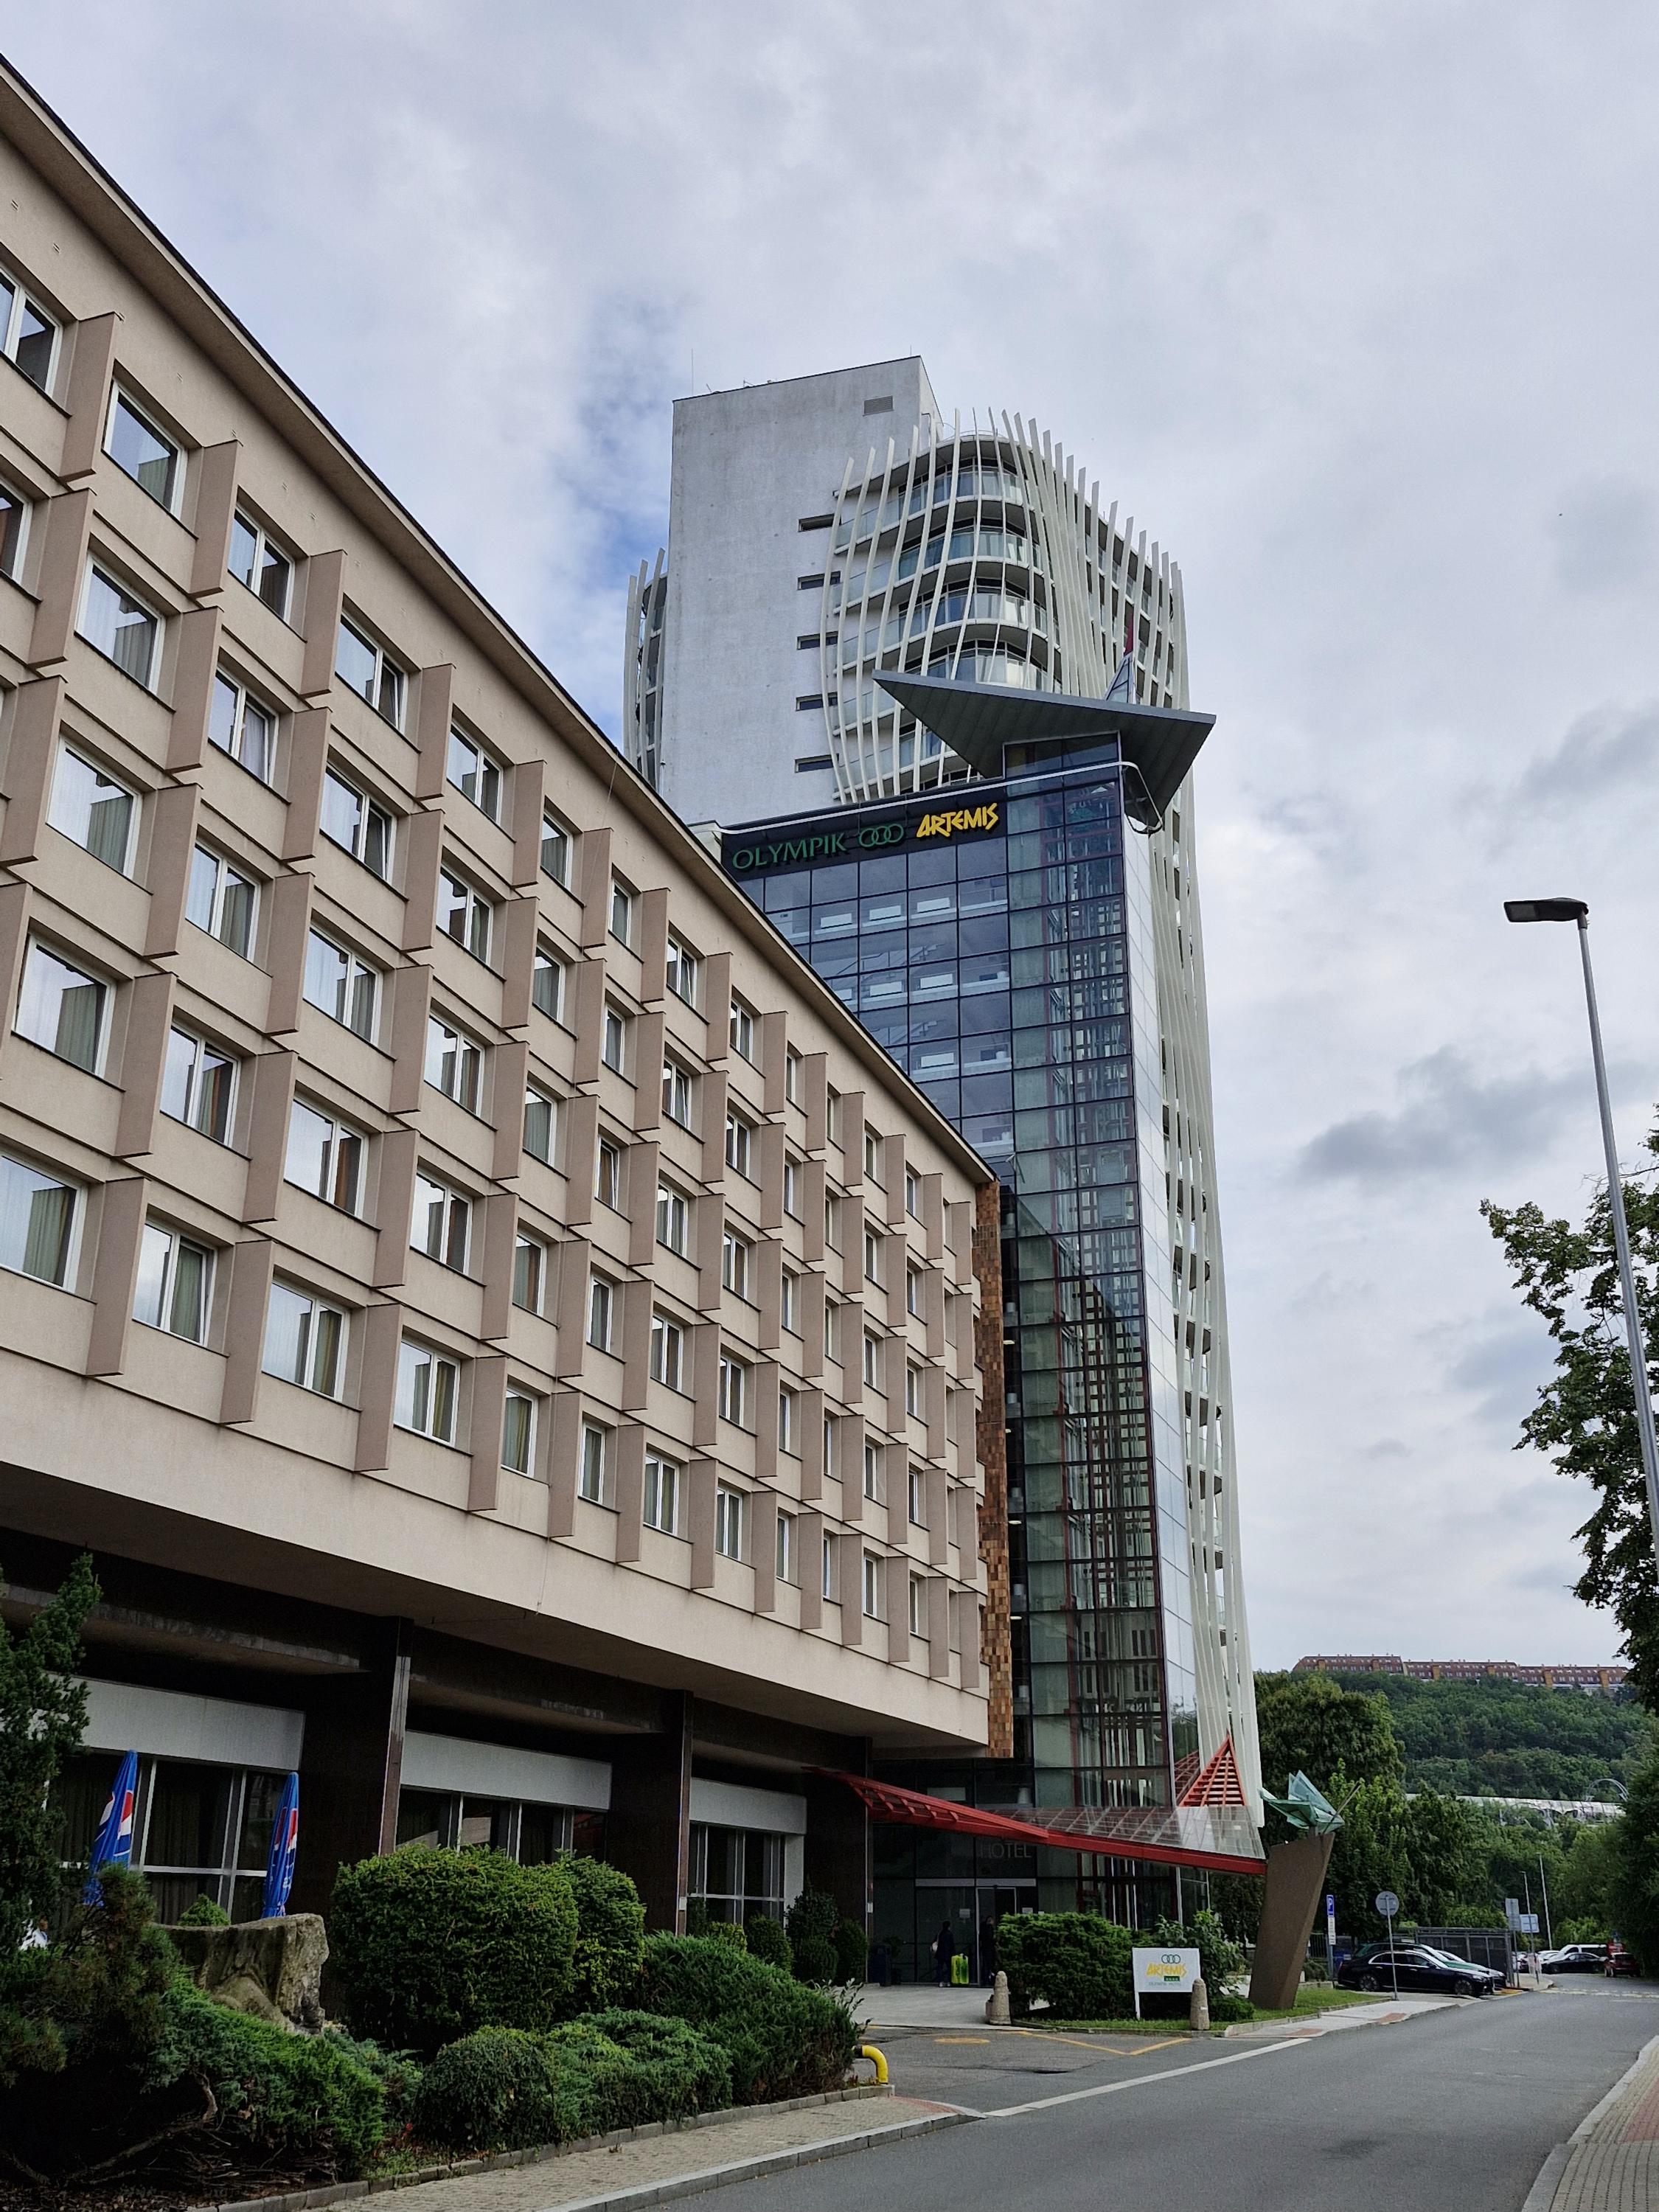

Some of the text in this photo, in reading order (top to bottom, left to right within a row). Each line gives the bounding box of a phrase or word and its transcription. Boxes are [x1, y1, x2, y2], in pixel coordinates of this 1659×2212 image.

[732, 803, 998, 869] OLYMPIK ARTEMIS
[981, 1843, 1032, 1858] HOTEL
[1147, 1963, 1188, 1979] ARTEMIS
